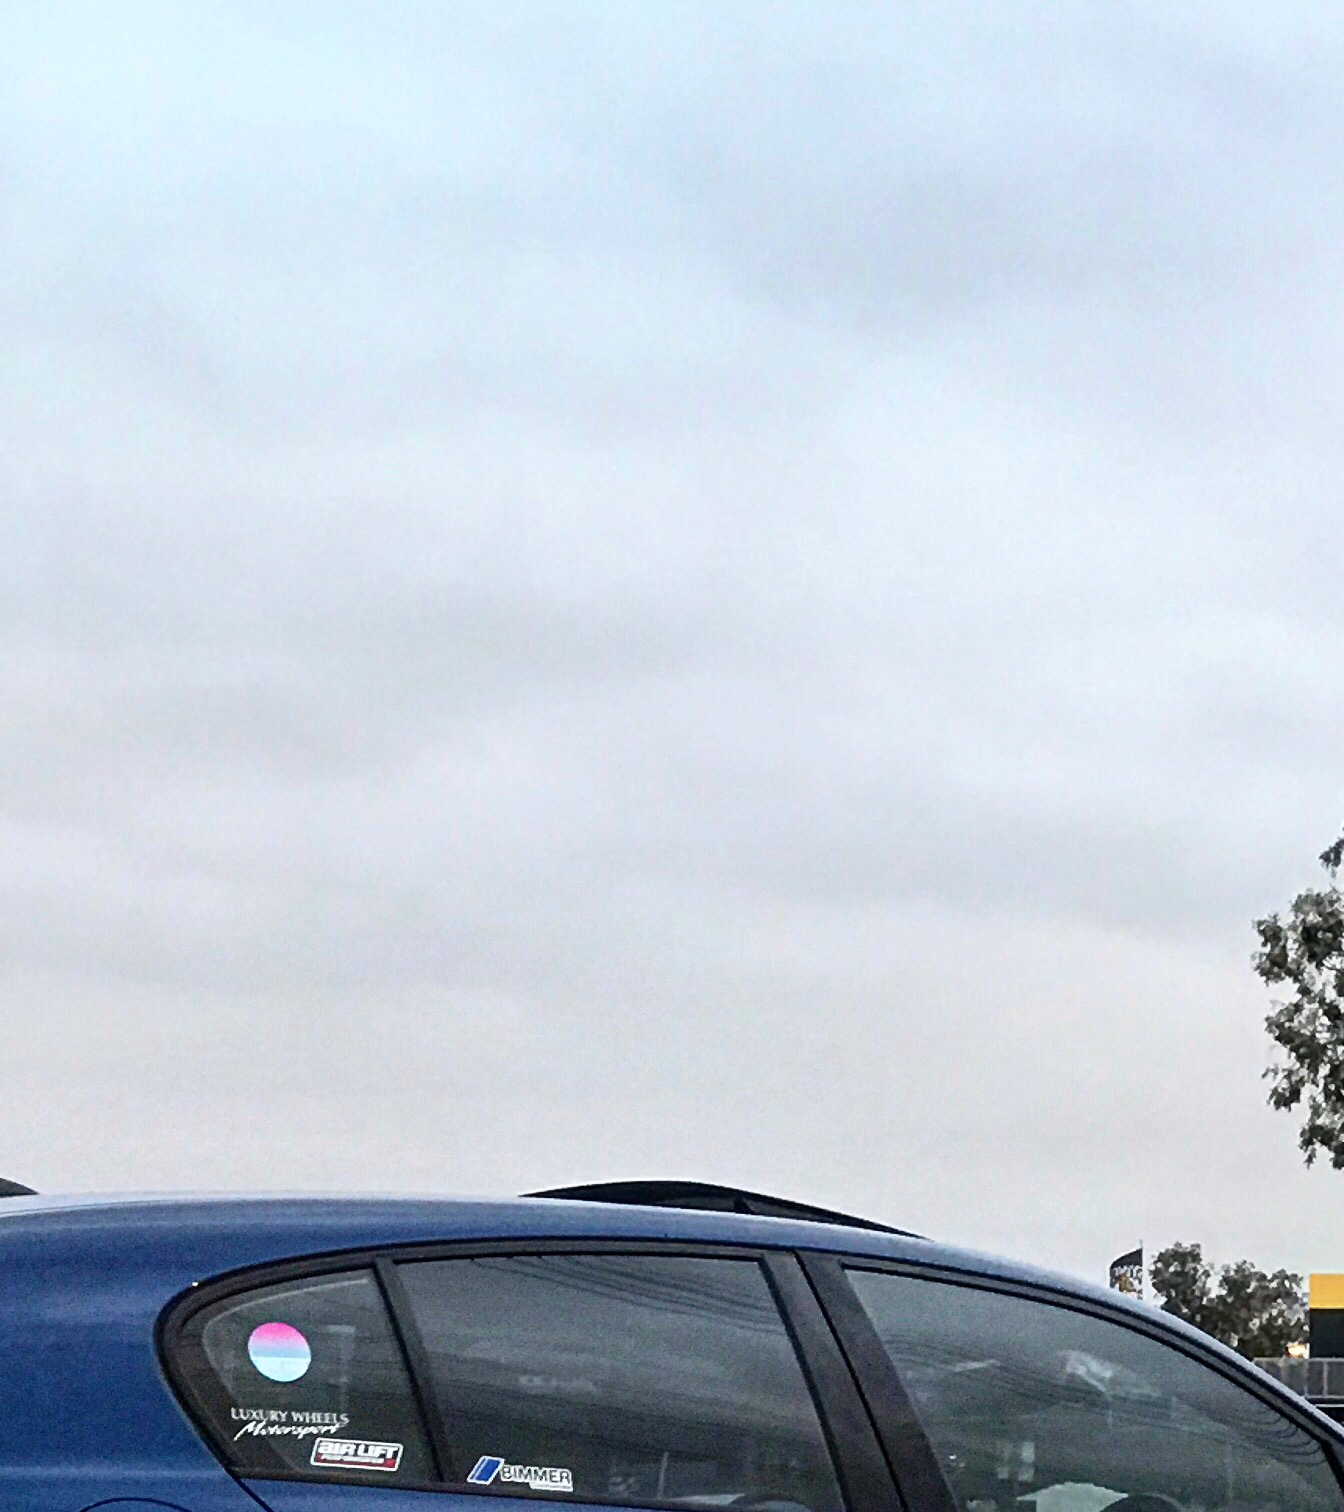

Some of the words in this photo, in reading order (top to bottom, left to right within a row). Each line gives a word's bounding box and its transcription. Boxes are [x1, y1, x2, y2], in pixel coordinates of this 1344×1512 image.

[230, 1407, 288, 1422] LUXURY
[291, 1411, 350, 1425] WHEELS
[356, 1442, 399, 1459] LIFT
[502, 1464, 572, 1484] BIMMER
